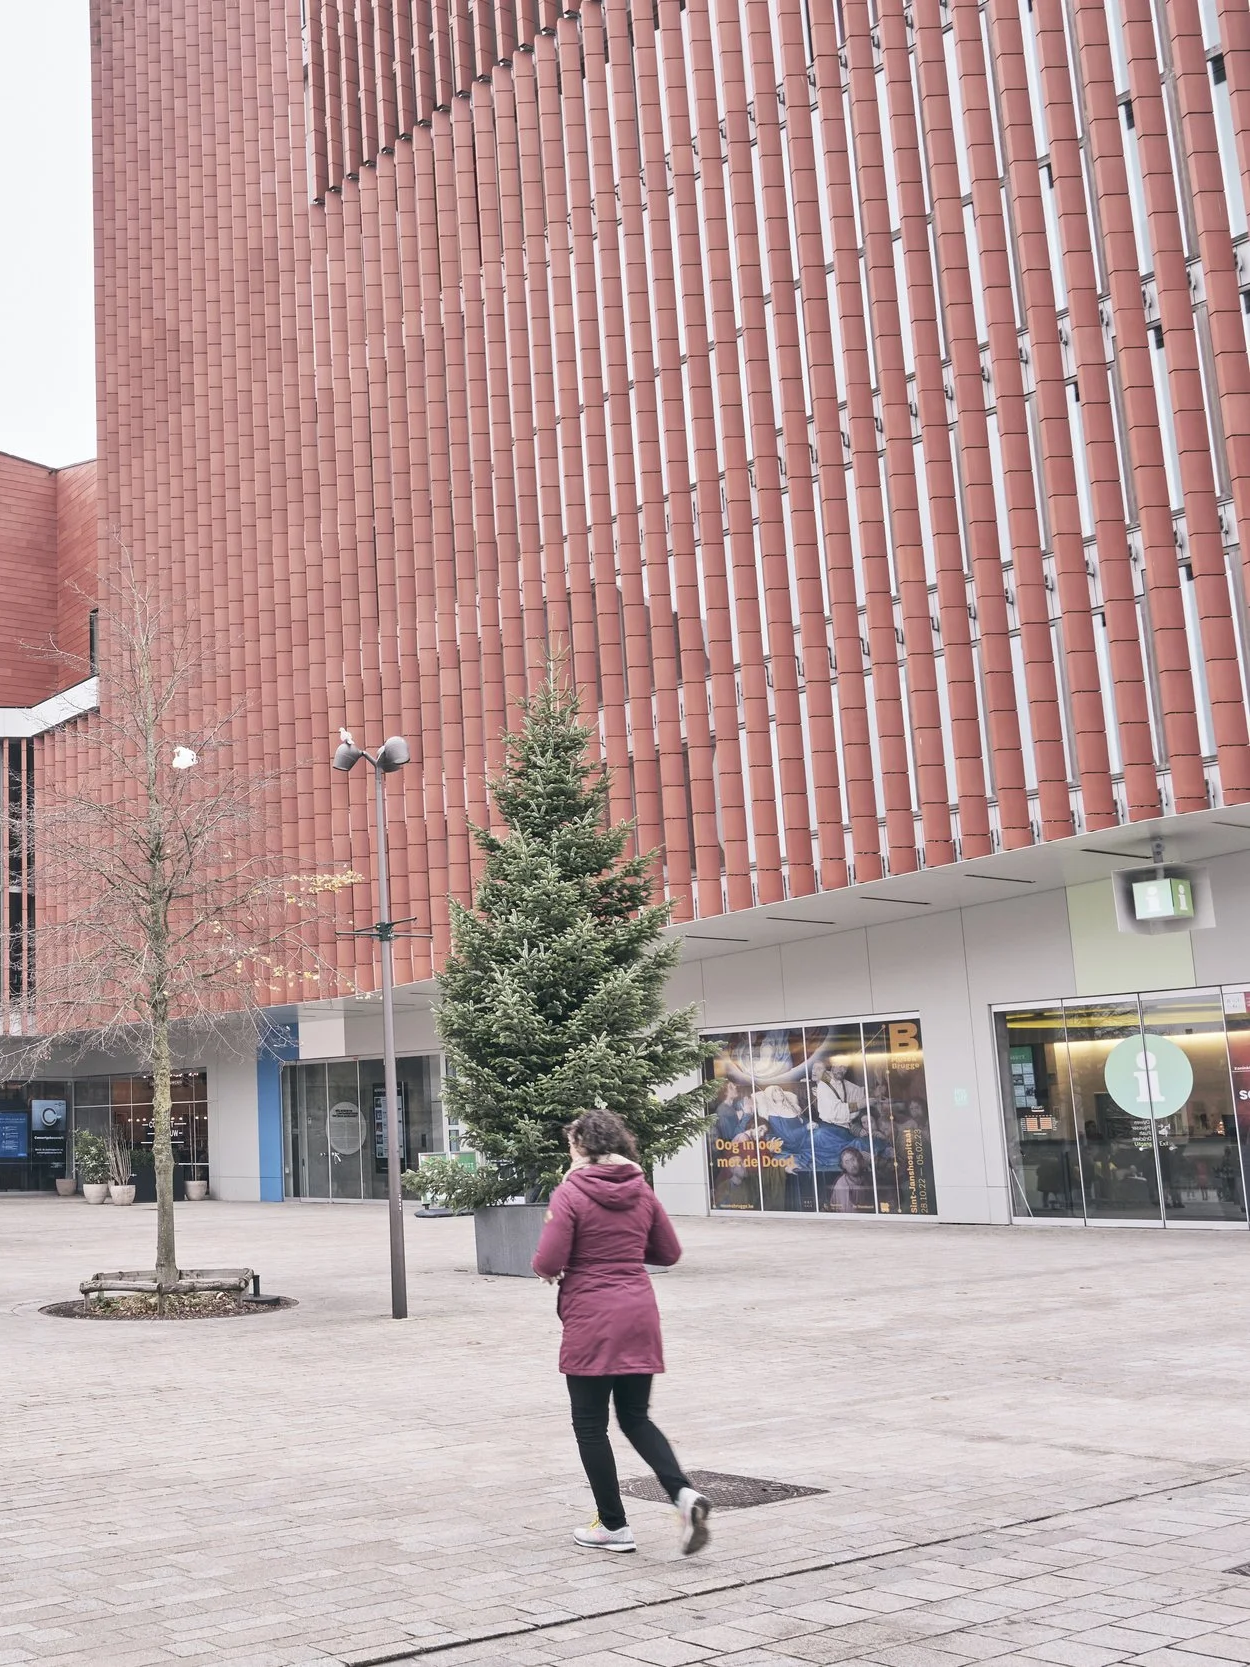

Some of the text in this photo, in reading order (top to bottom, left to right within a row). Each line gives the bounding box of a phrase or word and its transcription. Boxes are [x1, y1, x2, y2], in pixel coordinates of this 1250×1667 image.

[889, 1022, 919, 1053] B
[715, 1139, 783, 1154] Oog in oog
[717, 1154, 795, 1168] met de Dood
[914, 1129, 924, 1165] 05.02.23
[903, 1129, 918, 1214] Sint-Janshospitaal
[918, 1178, 929, 1214] 28.10.22
